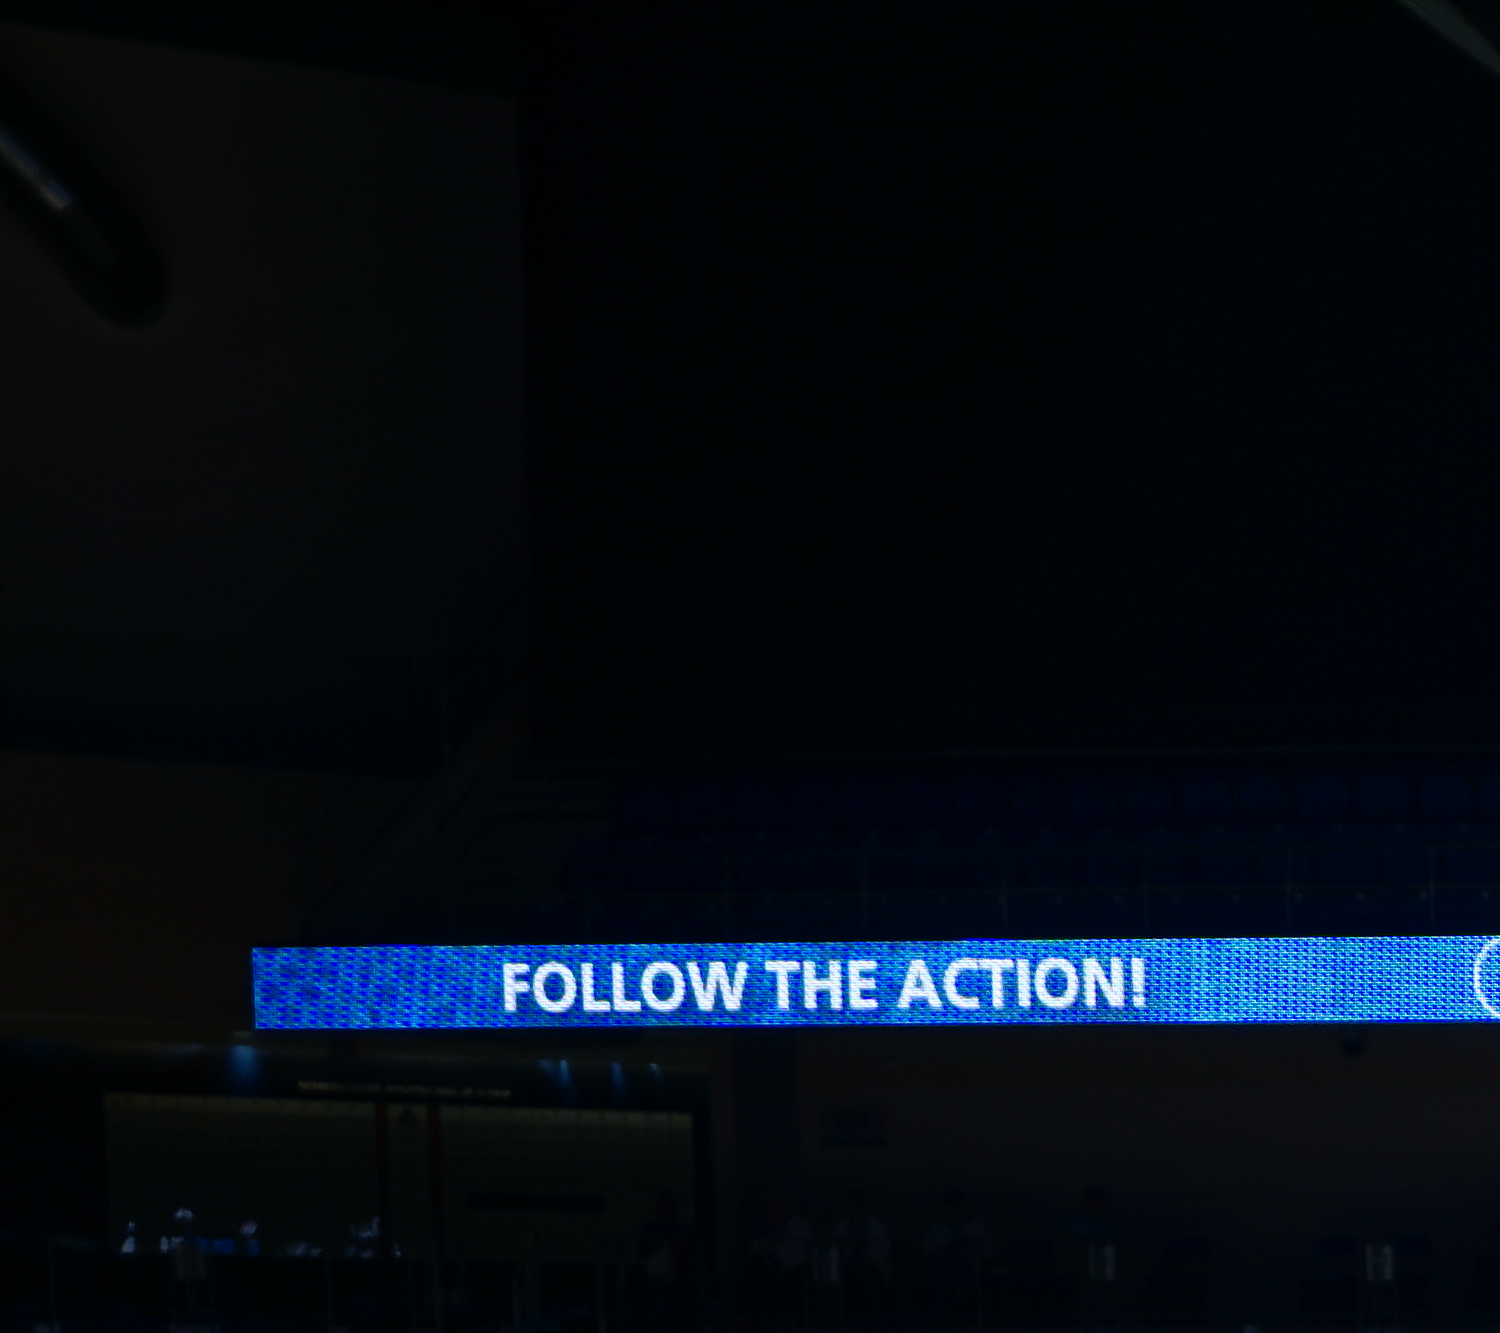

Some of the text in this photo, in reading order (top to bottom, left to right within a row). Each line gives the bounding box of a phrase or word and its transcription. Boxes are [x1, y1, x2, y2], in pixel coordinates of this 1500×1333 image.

[503, 955, 1147, 1015] FOLLOW THE ACTION!
